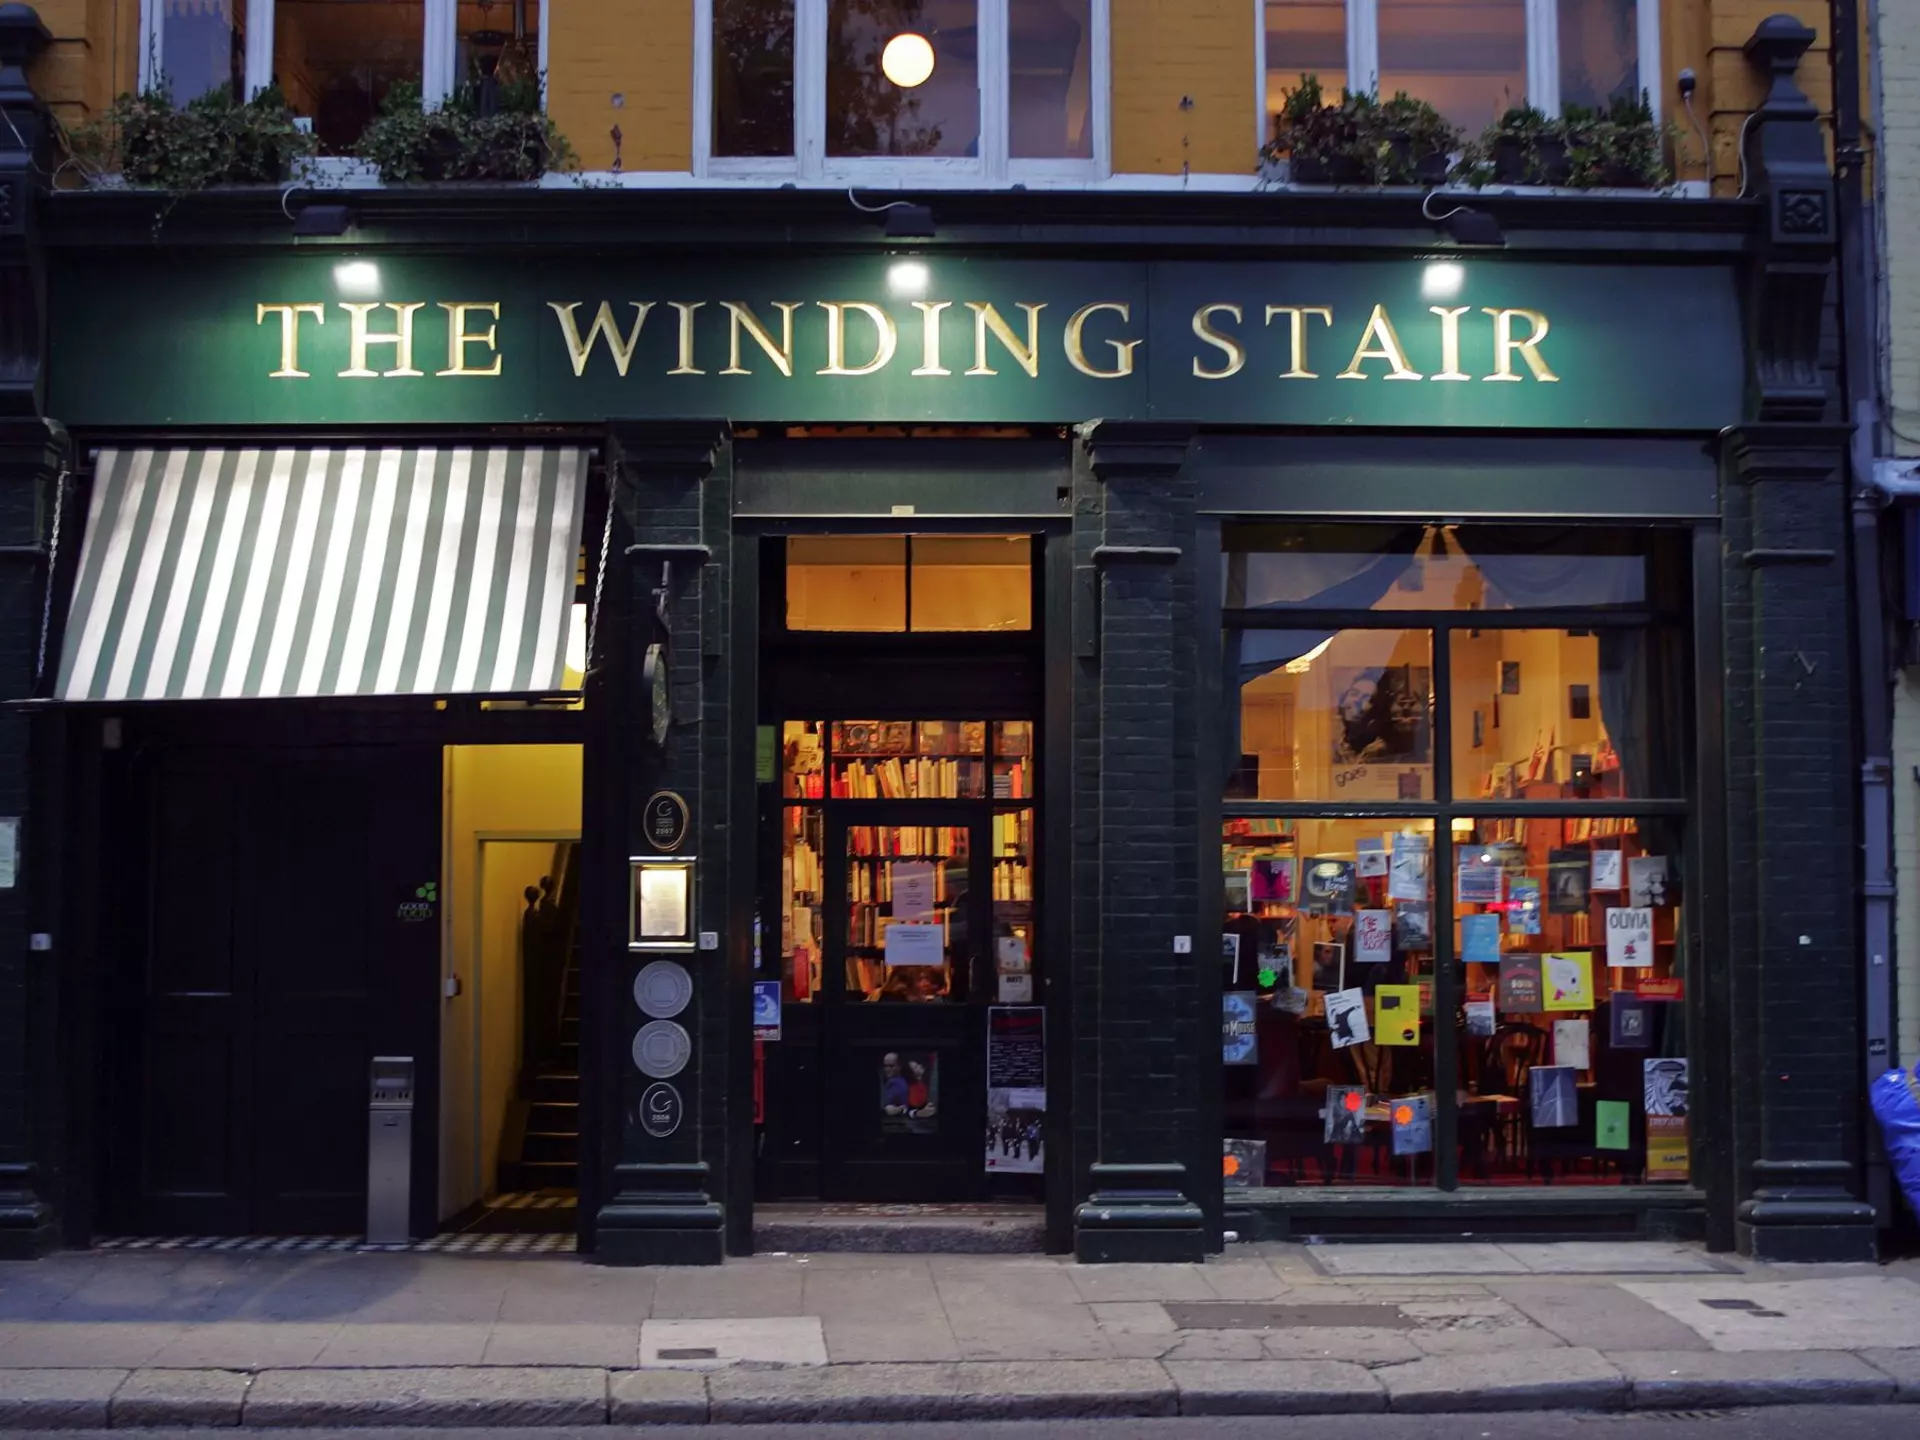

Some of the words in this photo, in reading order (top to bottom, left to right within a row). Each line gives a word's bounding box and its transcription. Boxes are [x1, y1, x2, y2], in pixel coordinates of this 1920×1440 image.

[256, 300, 502, 379] THE
[546, 300, 1143, 381] WINDING
[1191, 302, 1560, 383] STAIR
[1609, 912, 1650, 930] OLIVIA
